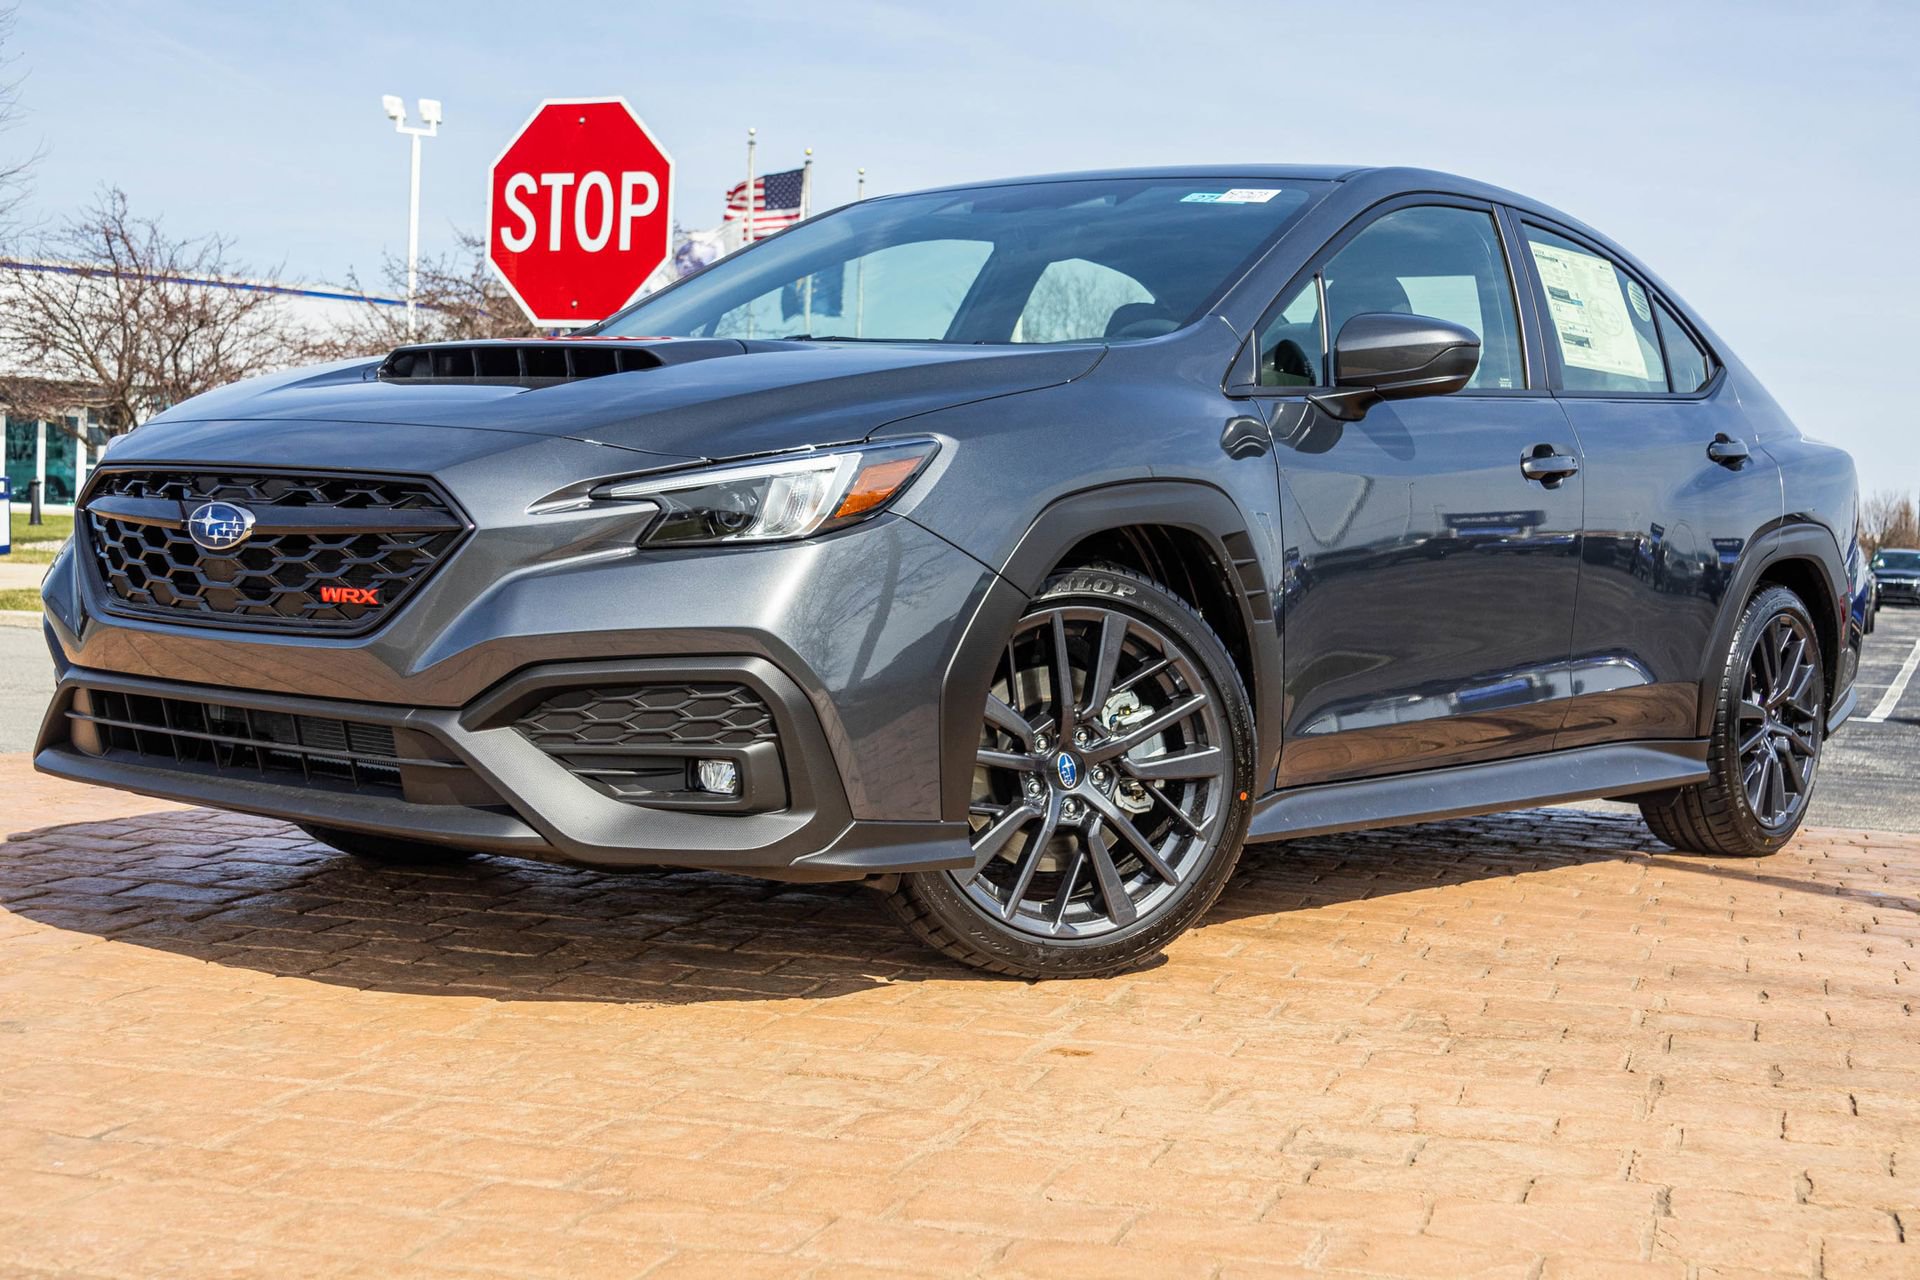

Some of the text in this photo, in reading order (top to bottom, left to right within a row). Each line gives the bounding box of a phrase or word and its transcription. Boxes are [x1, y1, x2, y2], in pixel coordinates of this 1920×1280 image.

[500, 170, 660, 253] STOP
[321, 586, 379, 604] WRX
[1056, 577, 1137, 597] NLOP
